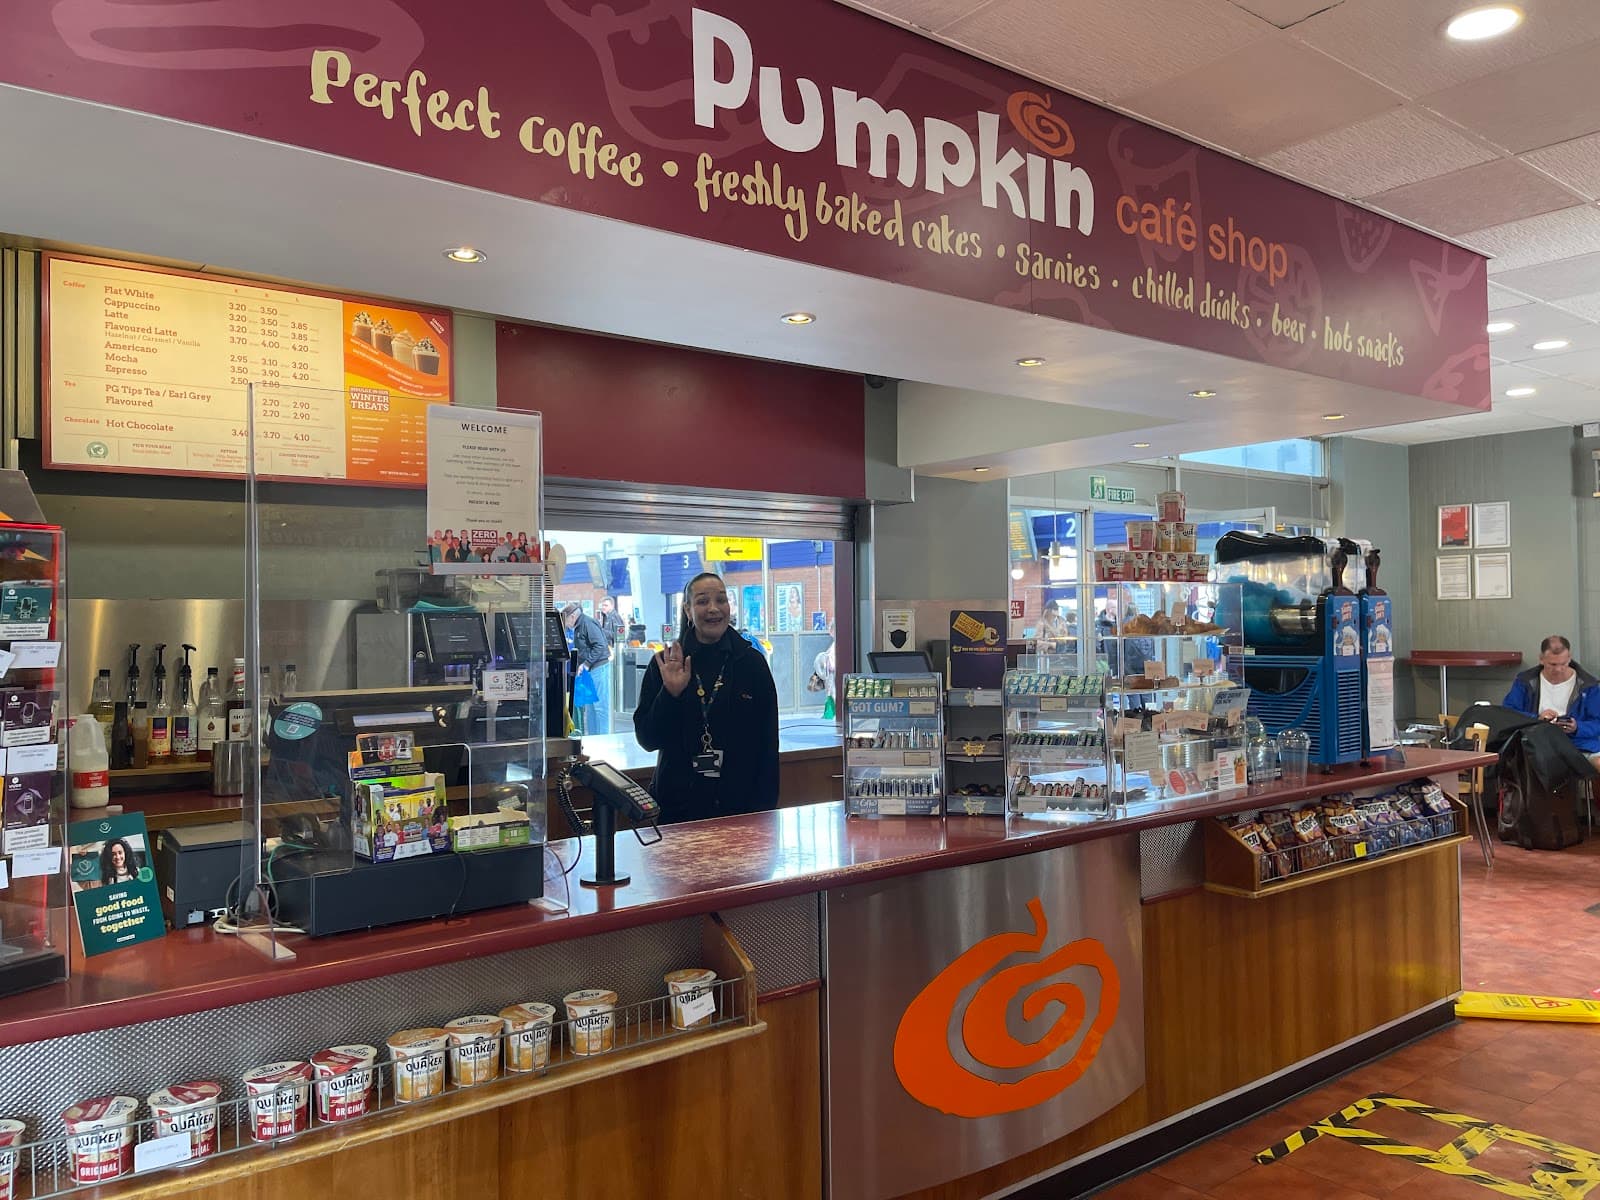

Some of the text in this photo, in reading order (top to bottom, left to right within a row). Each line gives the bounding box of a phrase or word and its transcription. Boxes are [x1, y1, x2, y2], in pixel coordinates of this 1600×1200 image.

[692, 7, 1095, 236] Pumpkin
[310, 49, 501, 137] Perfect
[695, 153, 809, 242] freshly
[815, 182, 905, 247] baked
[911, 215, 982, 261] cakes
[1132, 268, 1194, 315] chilled
[1200, 286, 1250, 329] drinks
[1271, 303, 1306, 345] beer
[1323, 317, 1353, 355] hot
[1357, 324, 1404, 369] snacks
[1116, 195, 1288, 287] café shop
[104, 286, 154, 299] Flat White
[104, 298, 160, 312] Cappuccino
[229, 302, 278, 316] 3.20 3.50
[104, 310, 129, 320] Latte
[229, 314, 308, 331] 3.20 3.50 3.85
[105, 322, 178, 337] Flavoured Latte
[229, 324, 308, 342] 3.20 3.50 3.85
[104, 342, 158, 354] Americano
[230, 336, 309, 353] 3.70 4.00 4.20
[105, 353, 138, 364] Mocha
[230, 354, 309, 370] 2.95 3.10 3.20
[105, 365, 148, 377] Espresso
[230, 366, 310, 381] 3.50 3.90 4.20
[231, 377, 248, 386] 2.50
[106, 384, 120, 393] PG
[121, 386, 142, 397] Tips
[145, 387, 160, 397] Tea
[169, 390, 188, 400] Earl
[189, 392, 212, 402] Grey
[350, 393, 390, 403] WINTER
[106, 396, 154, 408] Flavoured
[262, 399, 310, 410] 2.70 2.90
[351, 401, 390, 412] TREATS
[262, 410, 310, 421] 2.70 2.90
[106, 419, 174, 432] Hot Chocolate
[462, 423, 508, 434] WELCOME
[263, 431, 281, 439] 3.70
[294, 433, 310, 442] 4.10
[1108, 488, 1121, 501] FIRE
[473, 530, 497, 538] ZERO
[1066, 518, 1076, 538] 2
[683, 555, 689, 569] 3
[852, 701, 904, 713] GOT GUM?
[109, 892, 128, 901] SAVING
[96, 896, 144, 917] good food
[93, 916, 108, 926] FROM
[108, 913, 124, 921] GOING
[100, 916, 146, 933] together
[575, 1016, 610, 1028] QUAKER
[460, 1043, 496, 1057] QUAKER
[405, 1056, 443, 1072] QUAKER
[330, 1074, 370, 1091] QUAKER
[257, 1094, 300, 1109] QUAKER
[170, 1114, 214, 1132] QUAKER
[80, 1164, 118, 1177] ORIGINAL
